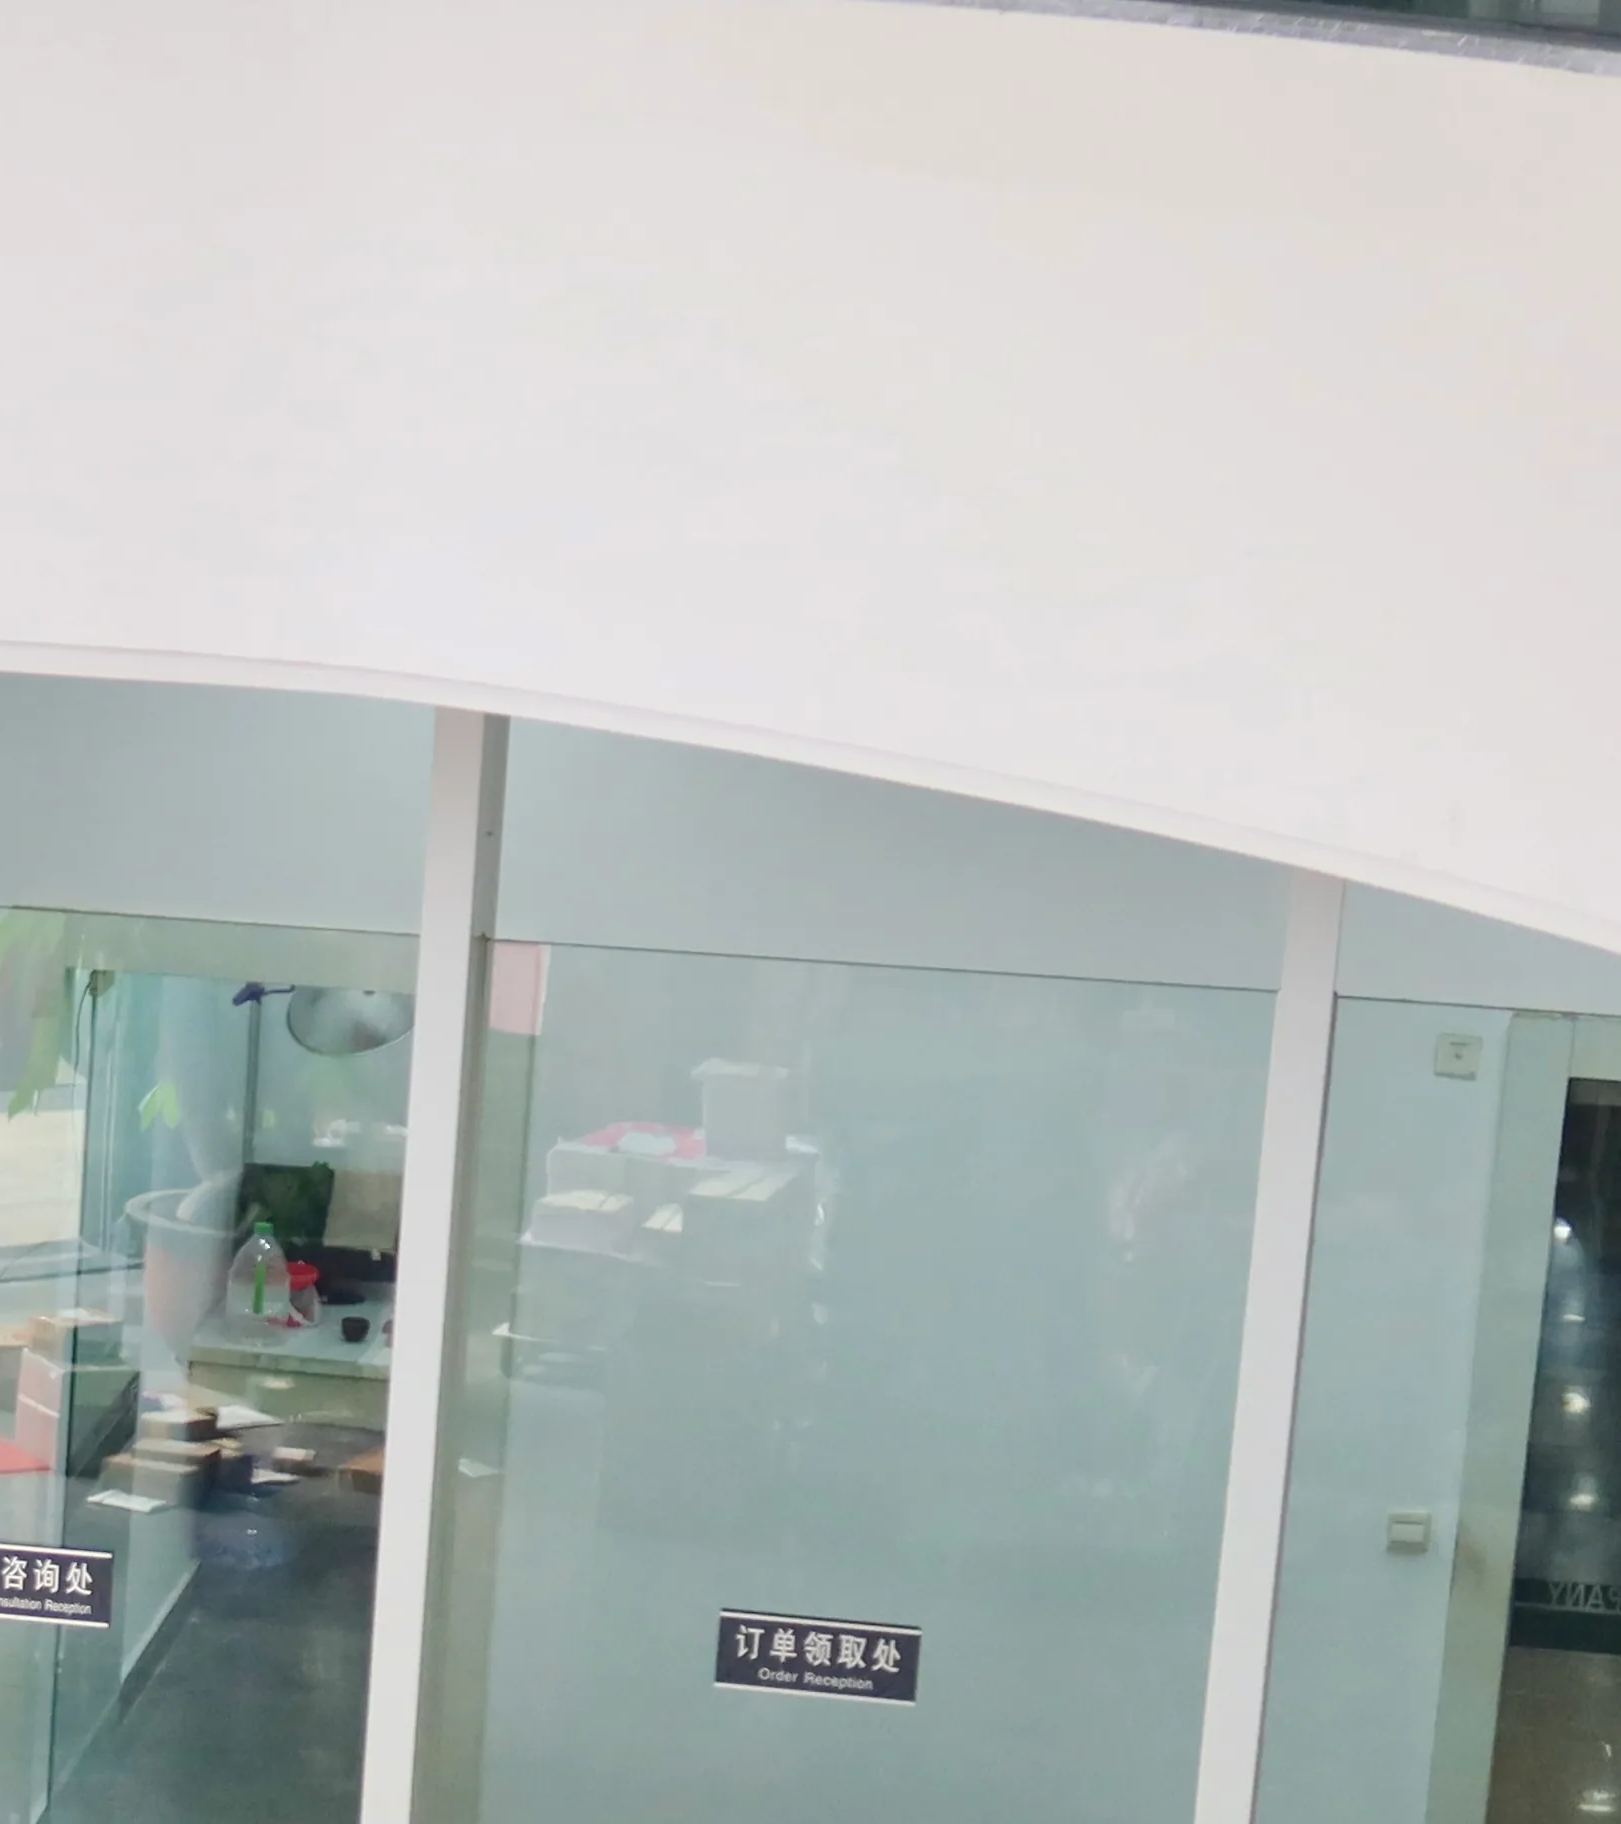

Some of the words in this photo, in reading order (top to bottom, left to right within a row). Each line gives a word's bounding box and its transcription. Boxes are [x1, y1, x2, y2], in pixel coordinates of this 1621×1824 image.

[44, 1599, 92, 1615] Reception
[735, 1624, 902, 1674] 订单领取处
[758, 1667, 799, 1682] Order
[803, 1672, 874, 1690] Reception
